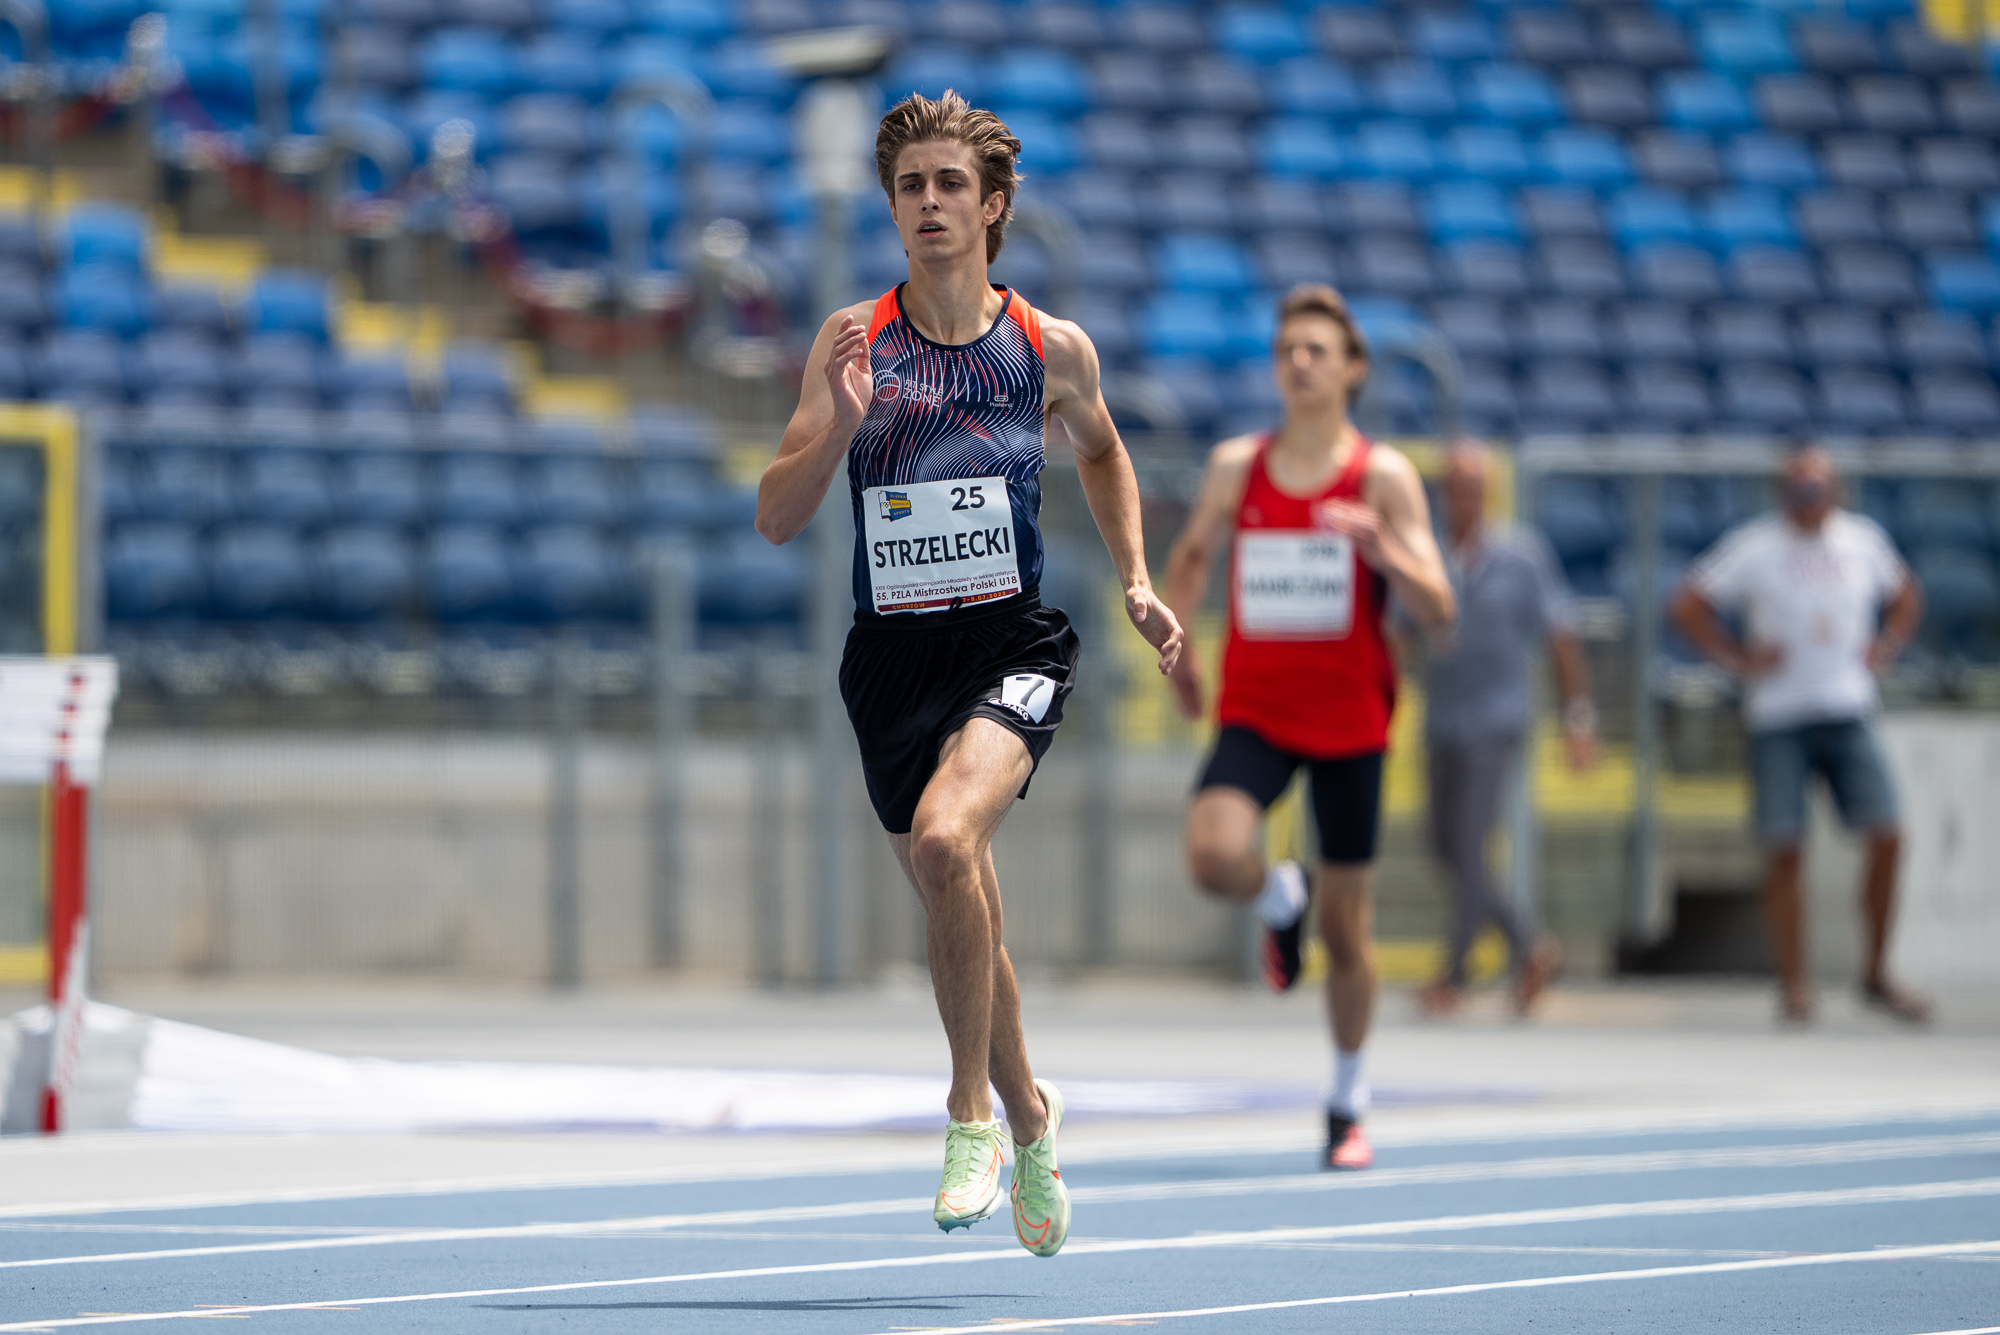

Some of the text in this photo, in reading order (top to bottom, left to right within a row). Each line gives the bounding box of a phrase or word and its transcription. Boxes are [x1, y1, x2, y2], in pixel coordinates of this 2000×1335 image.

[950, 485, 985, 511] 25
[873, 527, 1010, 568] STRZELECKI
[876, 576, 1017, 601] 55. PZLA Mistrzostwa Polski U18
[1015, 676, 1045, 707] 7
